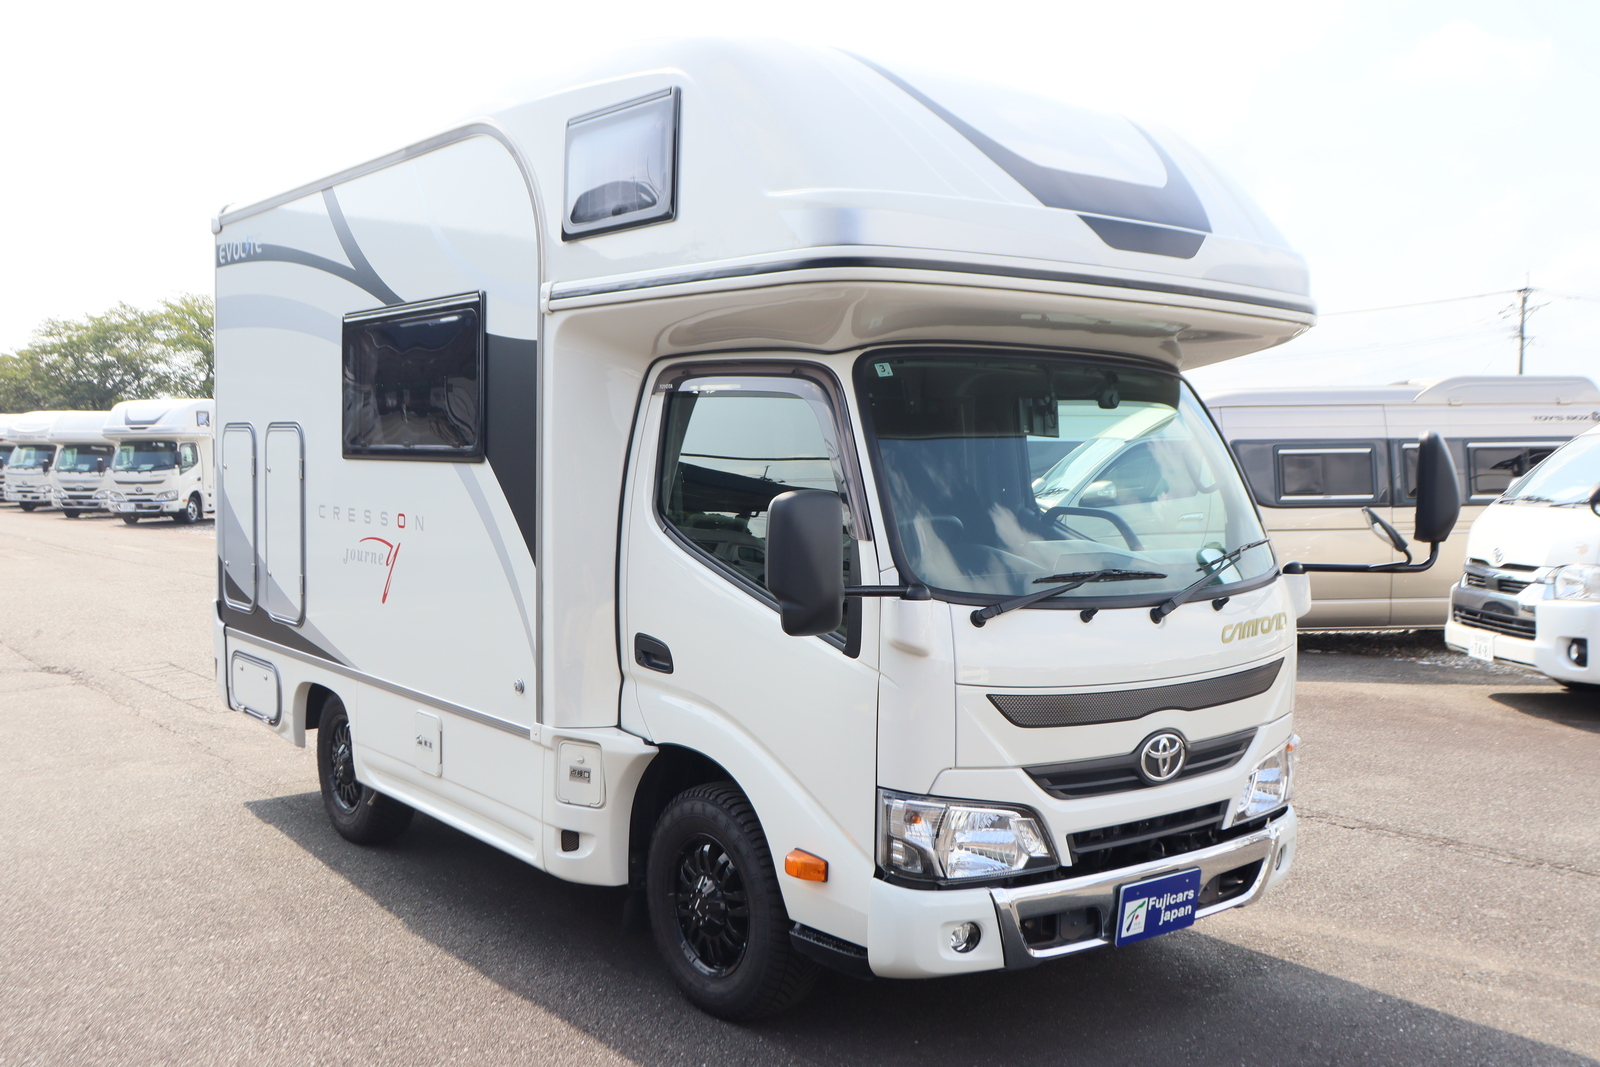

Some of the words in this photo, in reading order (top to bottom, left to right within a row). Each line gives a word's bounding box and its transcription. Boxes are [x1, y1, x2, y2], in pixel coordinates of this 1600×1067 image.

[318, 504, 424, 532] CRESSON
[1221, 612, 1287, 644] CAMROAD
[1148, 889, 1195, 911] Fujicars
[1158, 904, 1192, 926] japan
